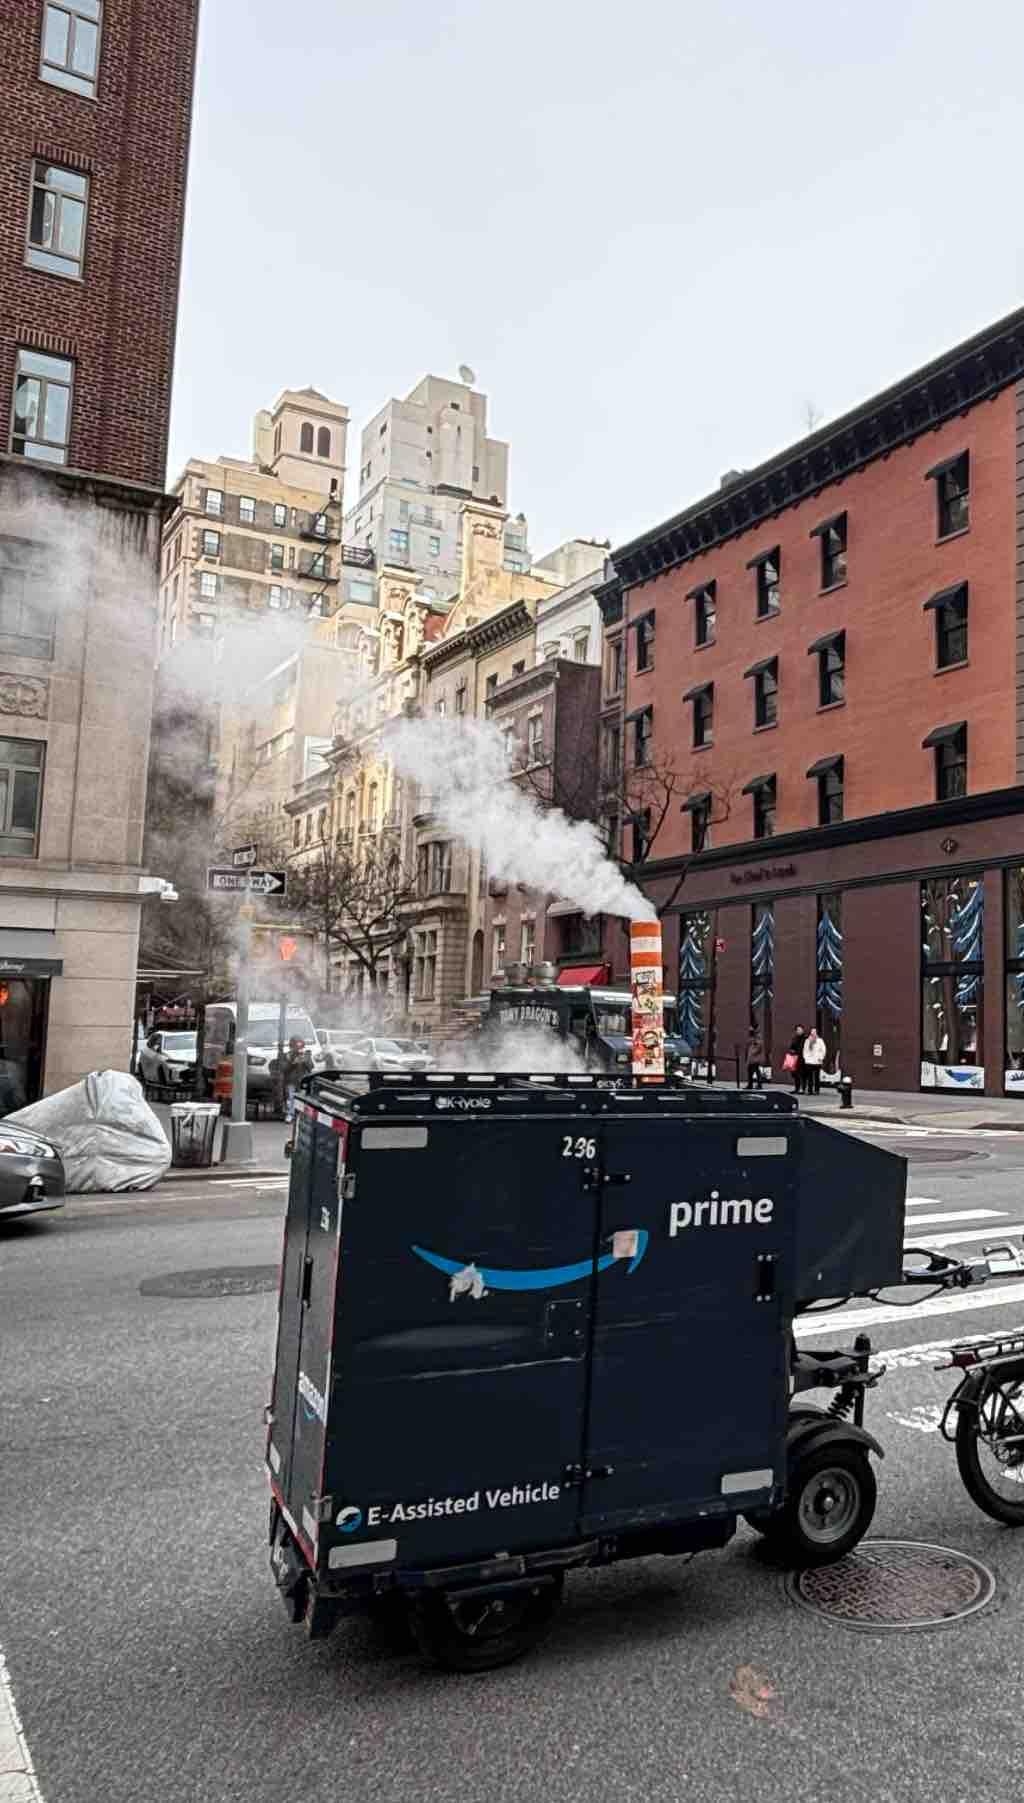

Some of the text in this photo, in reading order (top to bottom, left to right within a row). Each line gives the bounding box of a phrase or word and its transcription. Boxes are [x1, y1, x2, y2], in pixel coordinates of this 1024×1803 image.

[252, 877, 273, 889] WAY
[561, 1136, 596, 1159] 236
[669, 1190, 774, 1237] prime
[367, 1481, 560, 1526] E-Assisted Vehicle
